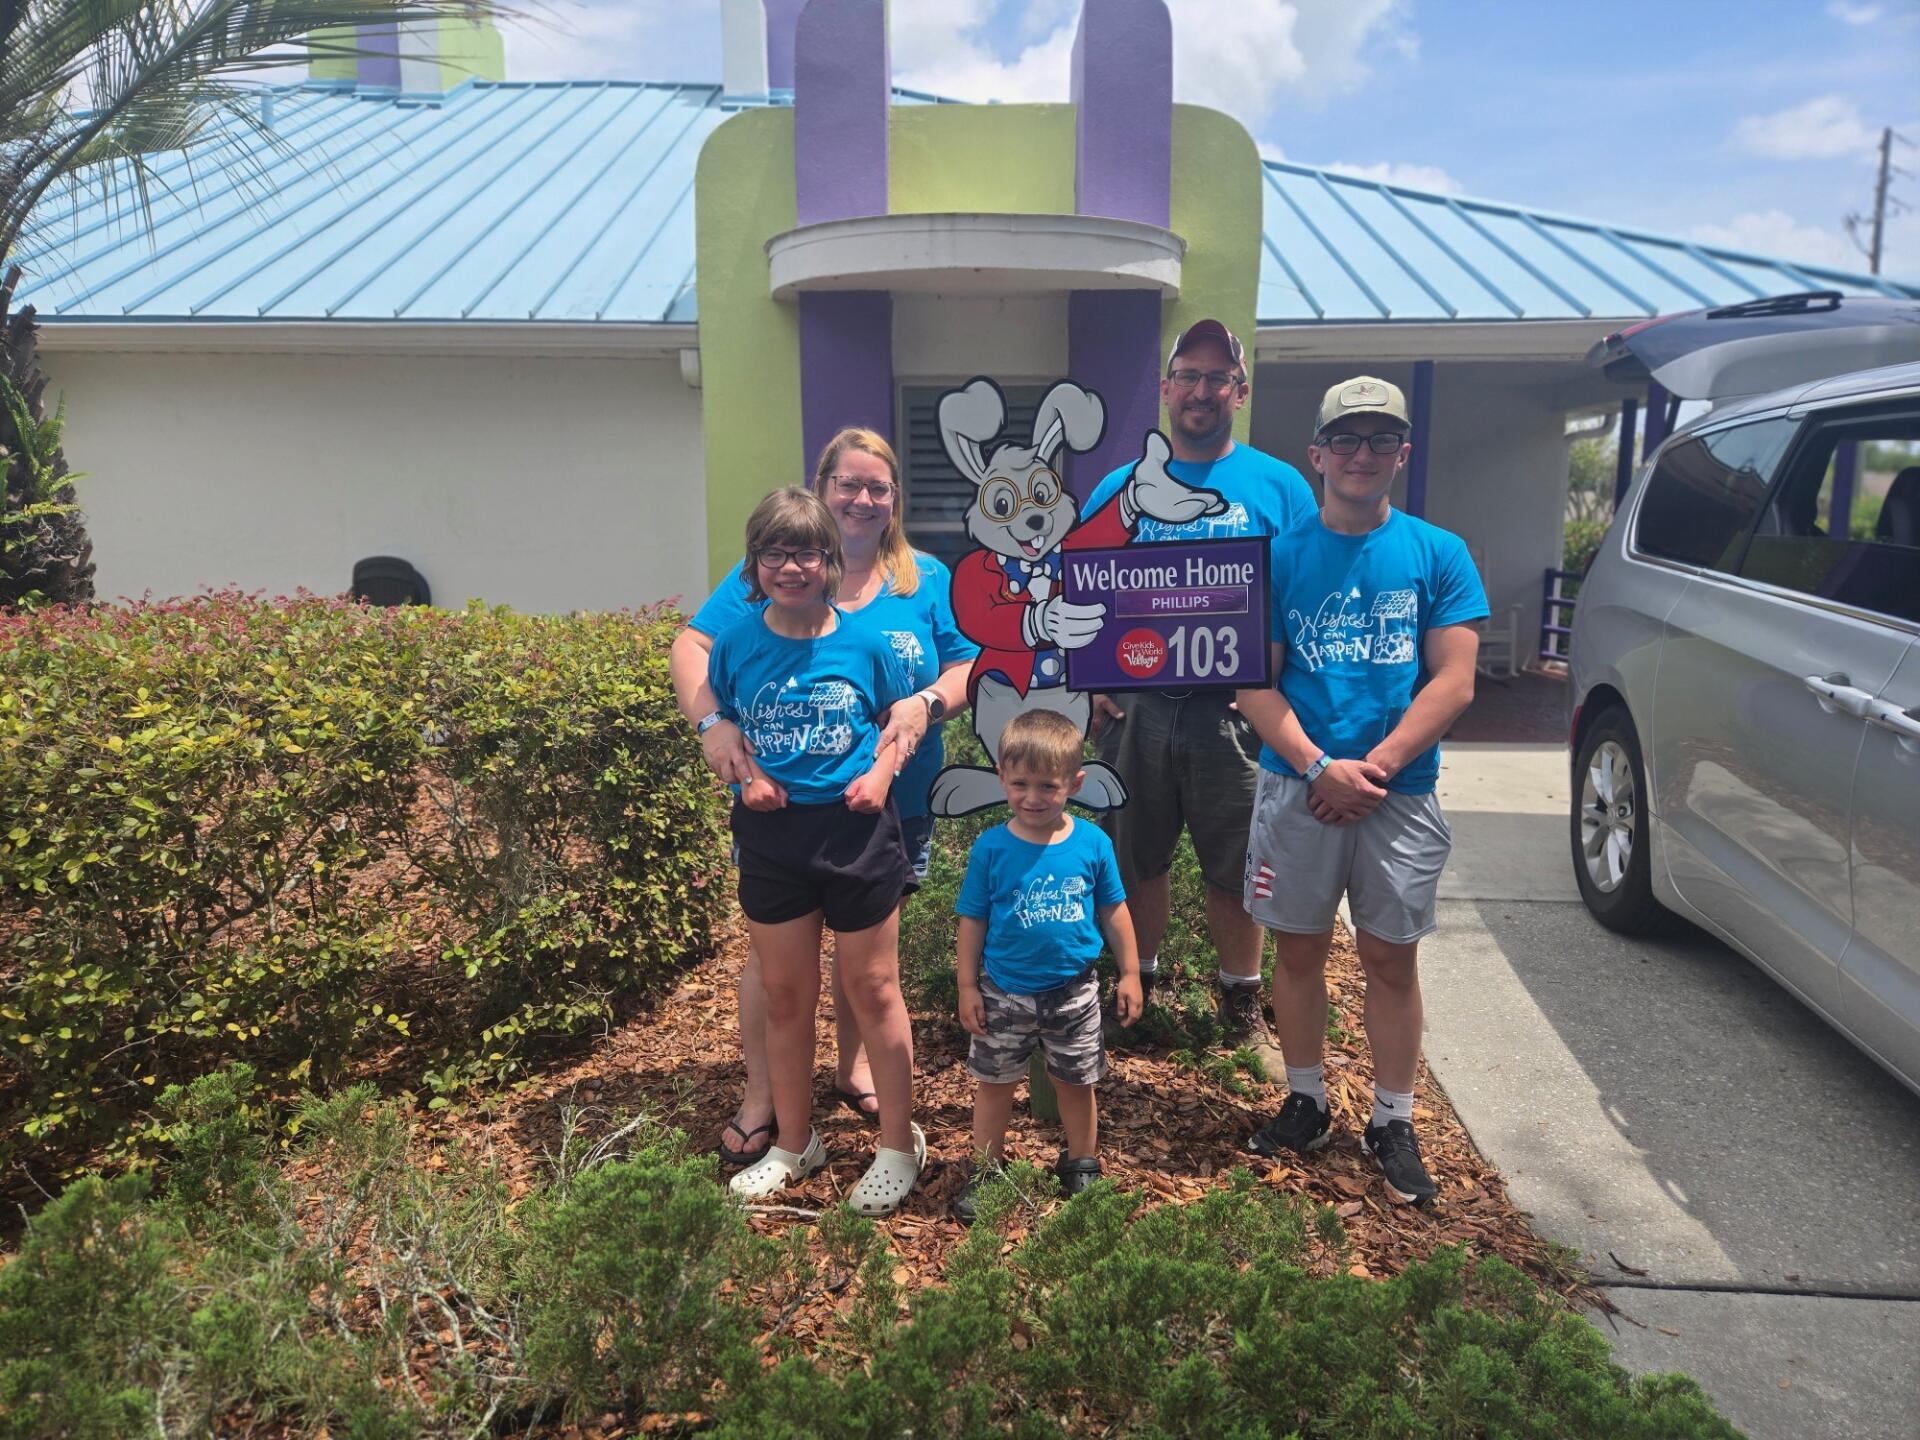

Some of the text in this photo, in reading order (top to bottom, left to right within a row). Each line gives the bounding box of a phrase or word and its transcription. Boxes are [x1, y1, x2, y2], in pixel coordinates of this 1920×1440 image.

[1073, 558, 1254, 591] Welcome Home
[1152, 595, 1210, 610] PHILLIPS
[1289, 591, 1374, 644] Wishes
[1142, 647, 1164, 656] World
[1168, 625, 1240, 677] 103
[1324, 630, 1346, 640] CAN
[1297, 634, 1374, 672] HAPPEN
[735, 682, 811, 729] Wishes
[745, 724, 812, 758] HAPPEN
[763, 721, 784, 730] CAN
[1013, 877, 1063, 911] Wishes
[1015, 903, 1063, 929] HAPPEN
